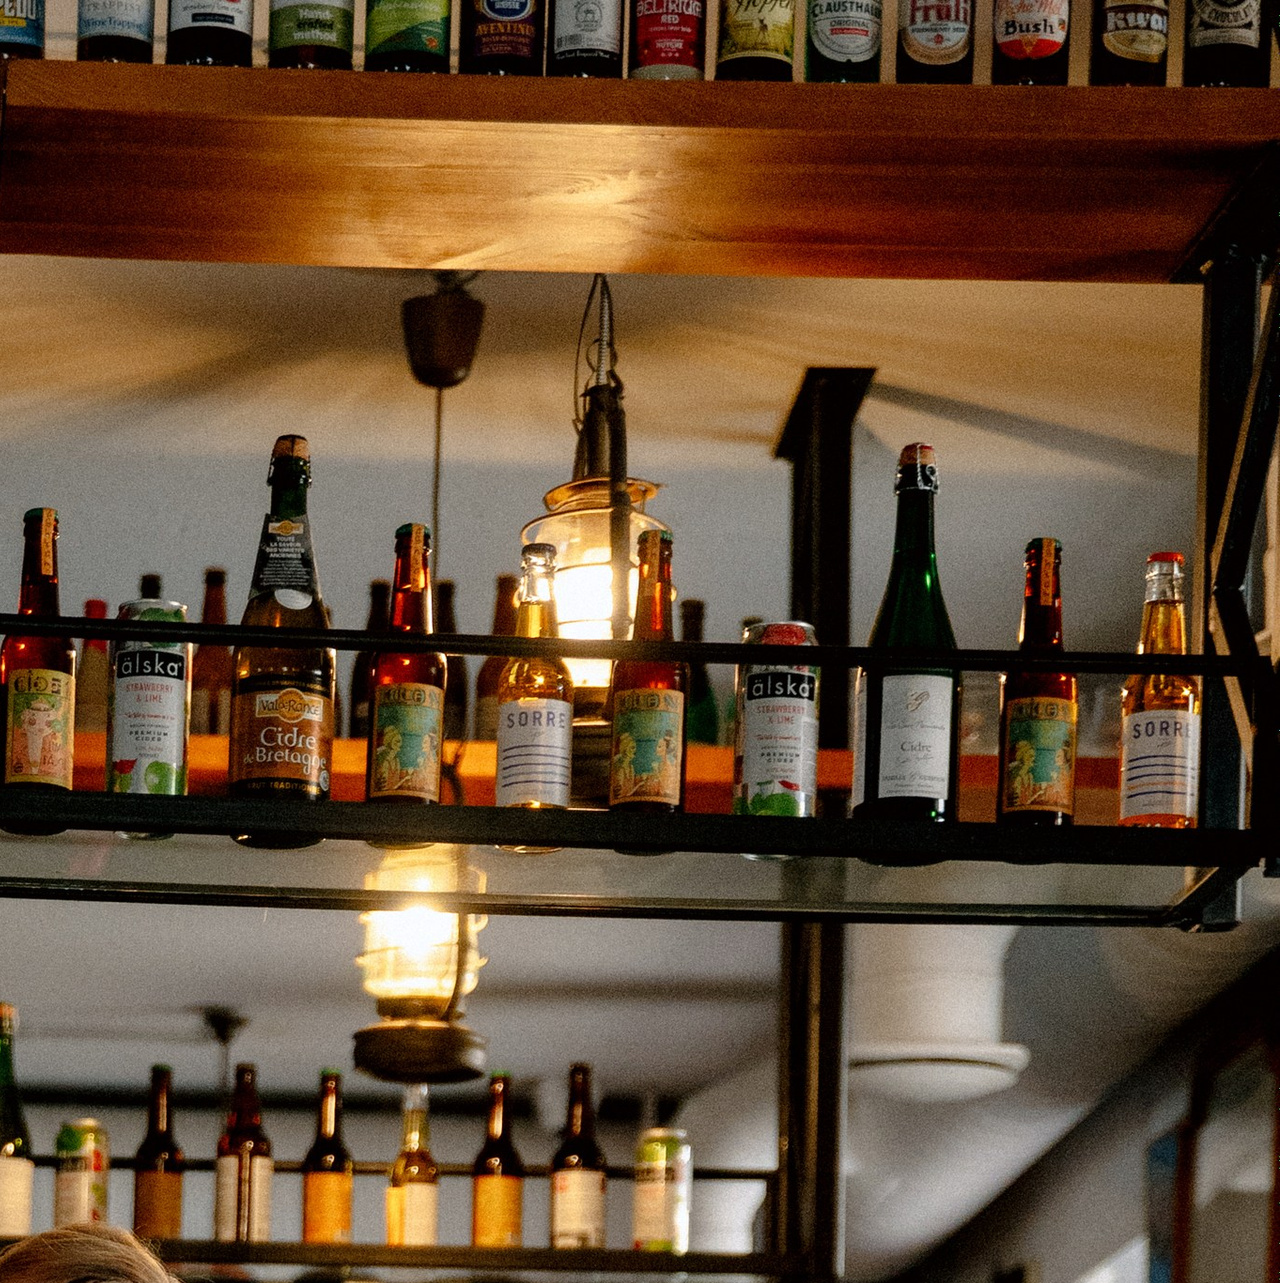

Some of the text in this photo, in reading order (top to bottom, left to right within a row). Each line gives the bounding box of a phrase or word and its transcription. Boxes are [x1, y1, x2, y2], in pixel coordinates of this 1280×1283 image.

[1004, 19, 1053, 35] Bush
[121, 653, 178, 676] älska
[752, 674, 810, 697] älska
[145, 694, 162, 703] LIME
[777, 715, 794, 724] LIME
[260, 726, 316, 750] Cidre
[255, 747, 326, 775] Bretagne
